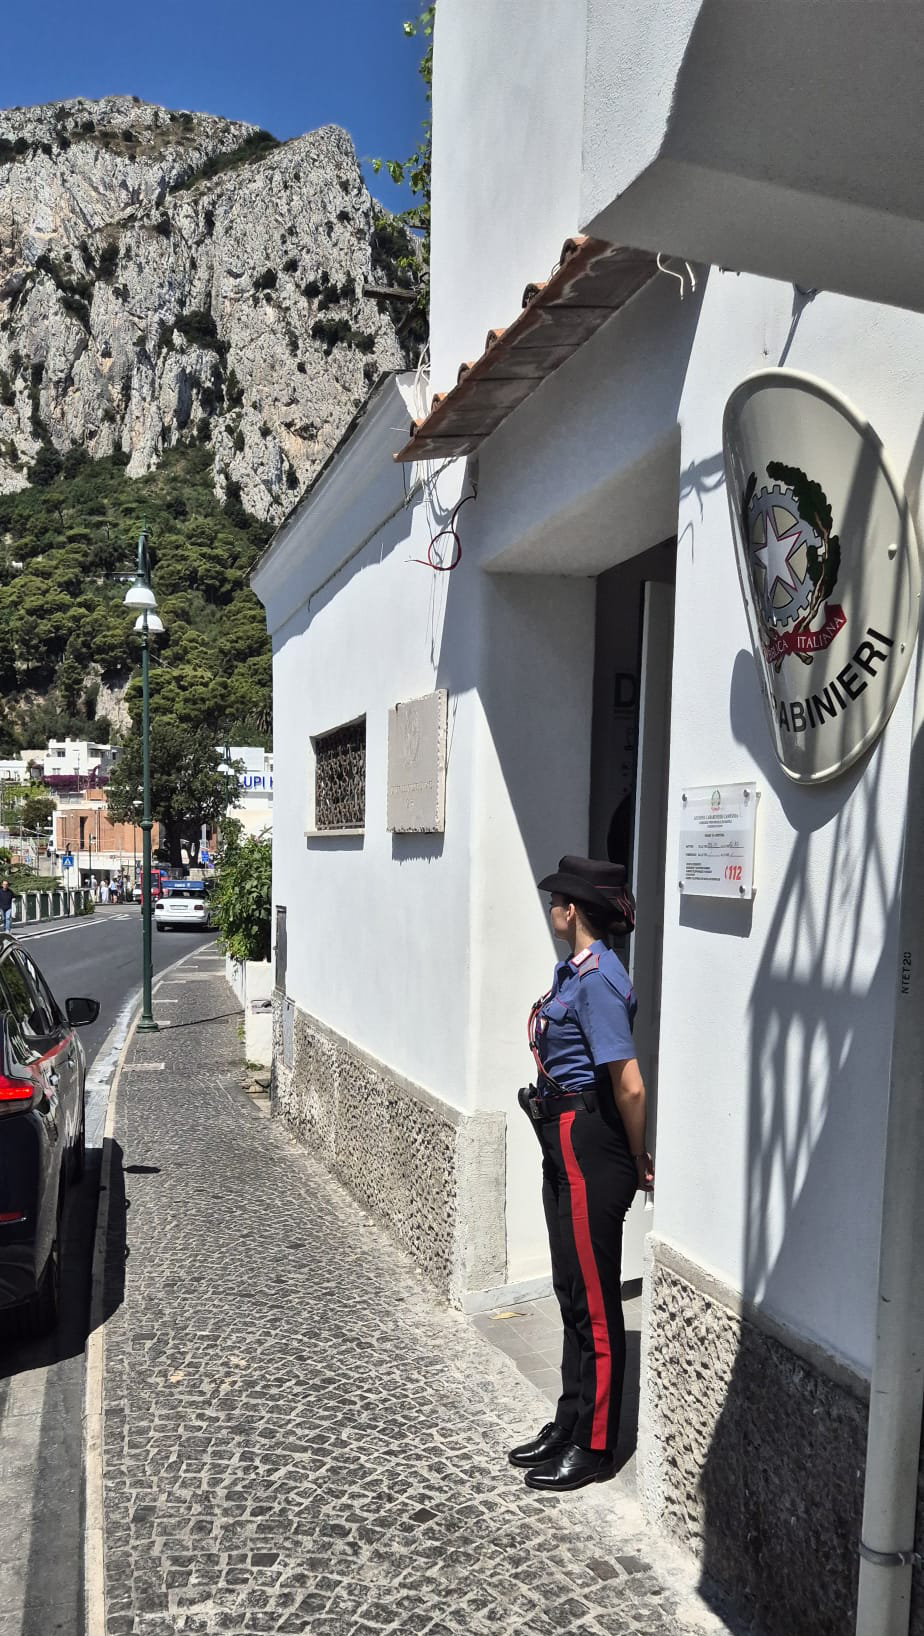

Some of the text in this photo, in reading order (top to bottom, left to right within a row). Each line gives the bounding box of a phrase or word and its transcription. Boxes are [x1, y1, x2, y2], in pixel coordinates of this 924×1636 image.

[796, 617, 844, 649] ITALIANA
[773, 627, 894, 732] ABINIERI
[728, 865, 743, 881] 112
